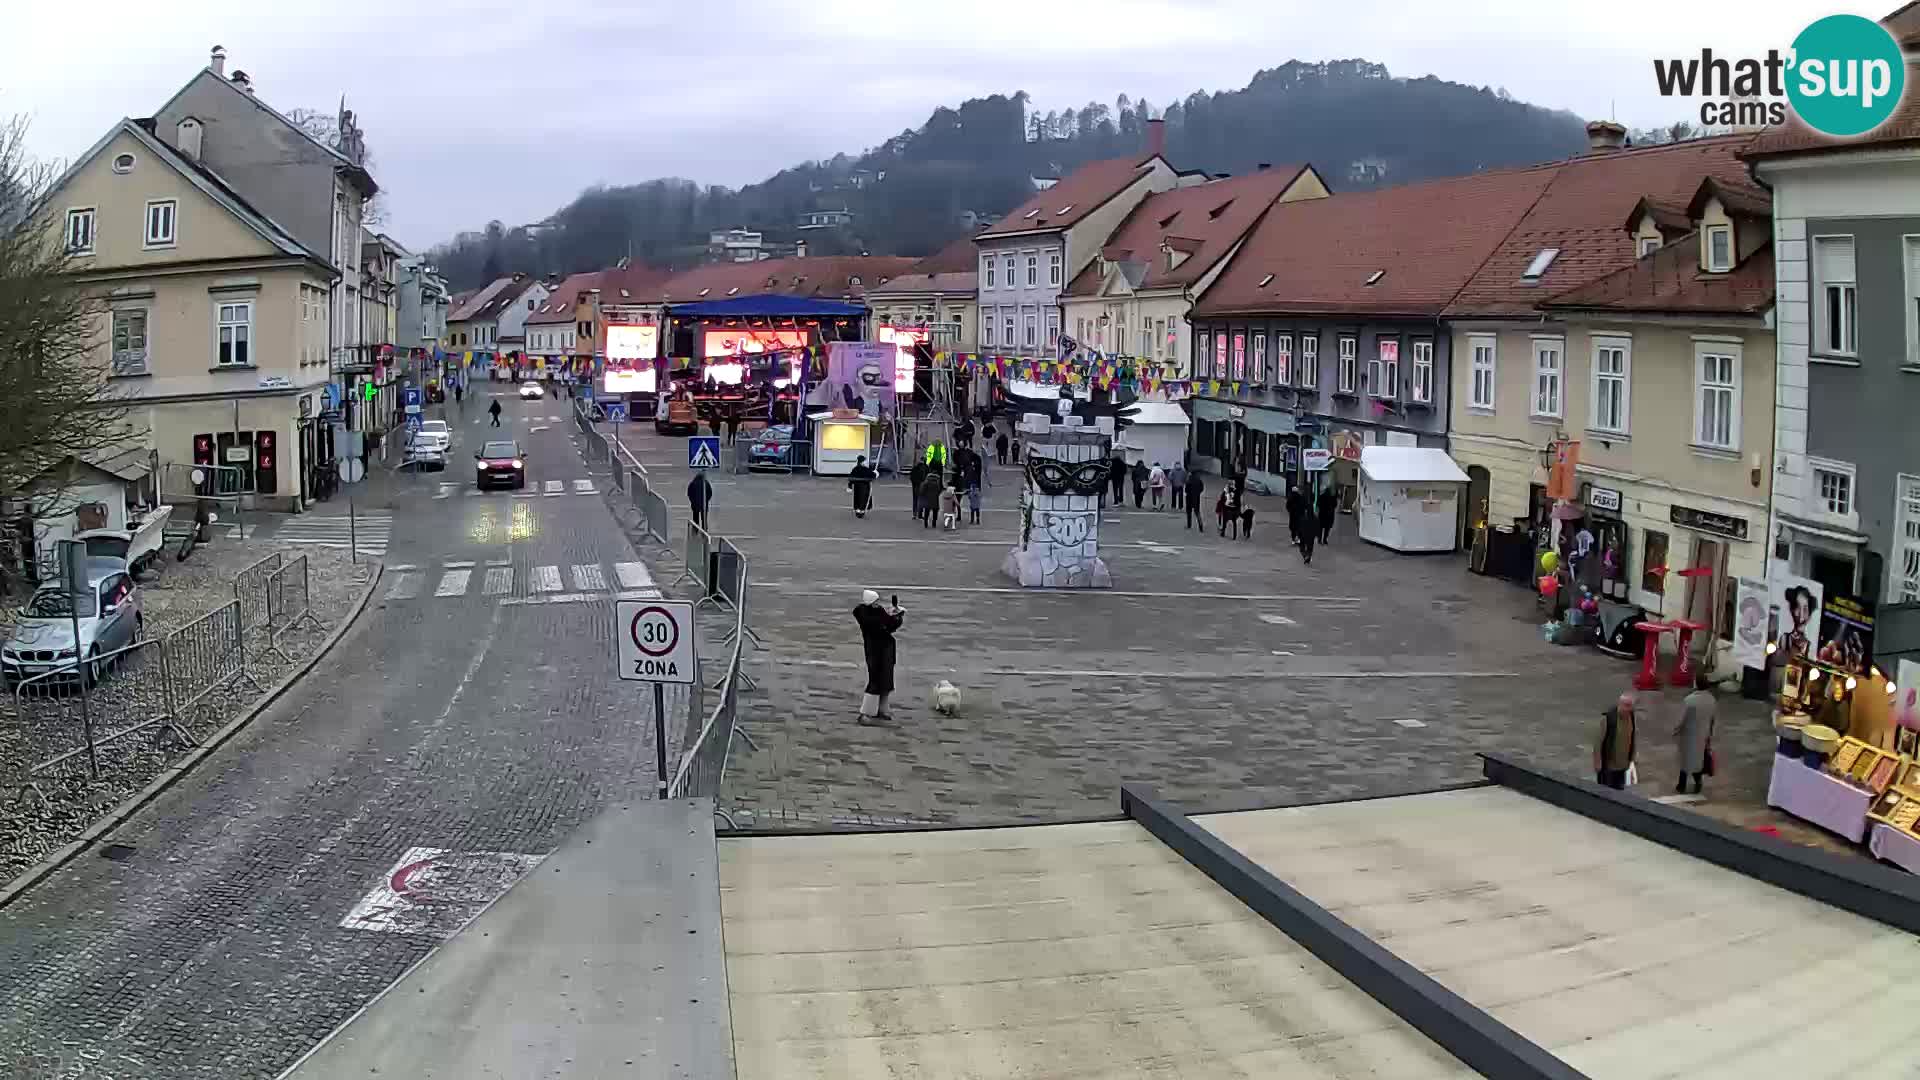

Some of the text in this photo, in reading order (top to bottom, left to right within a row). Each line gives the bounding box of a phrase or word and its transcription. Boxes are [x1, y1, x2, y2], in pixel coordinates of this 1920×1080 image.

[1048, 516, 1087, 545] 200
[643, 622, 668, 643] 30
[633, 660, 678, 677] ZONA
